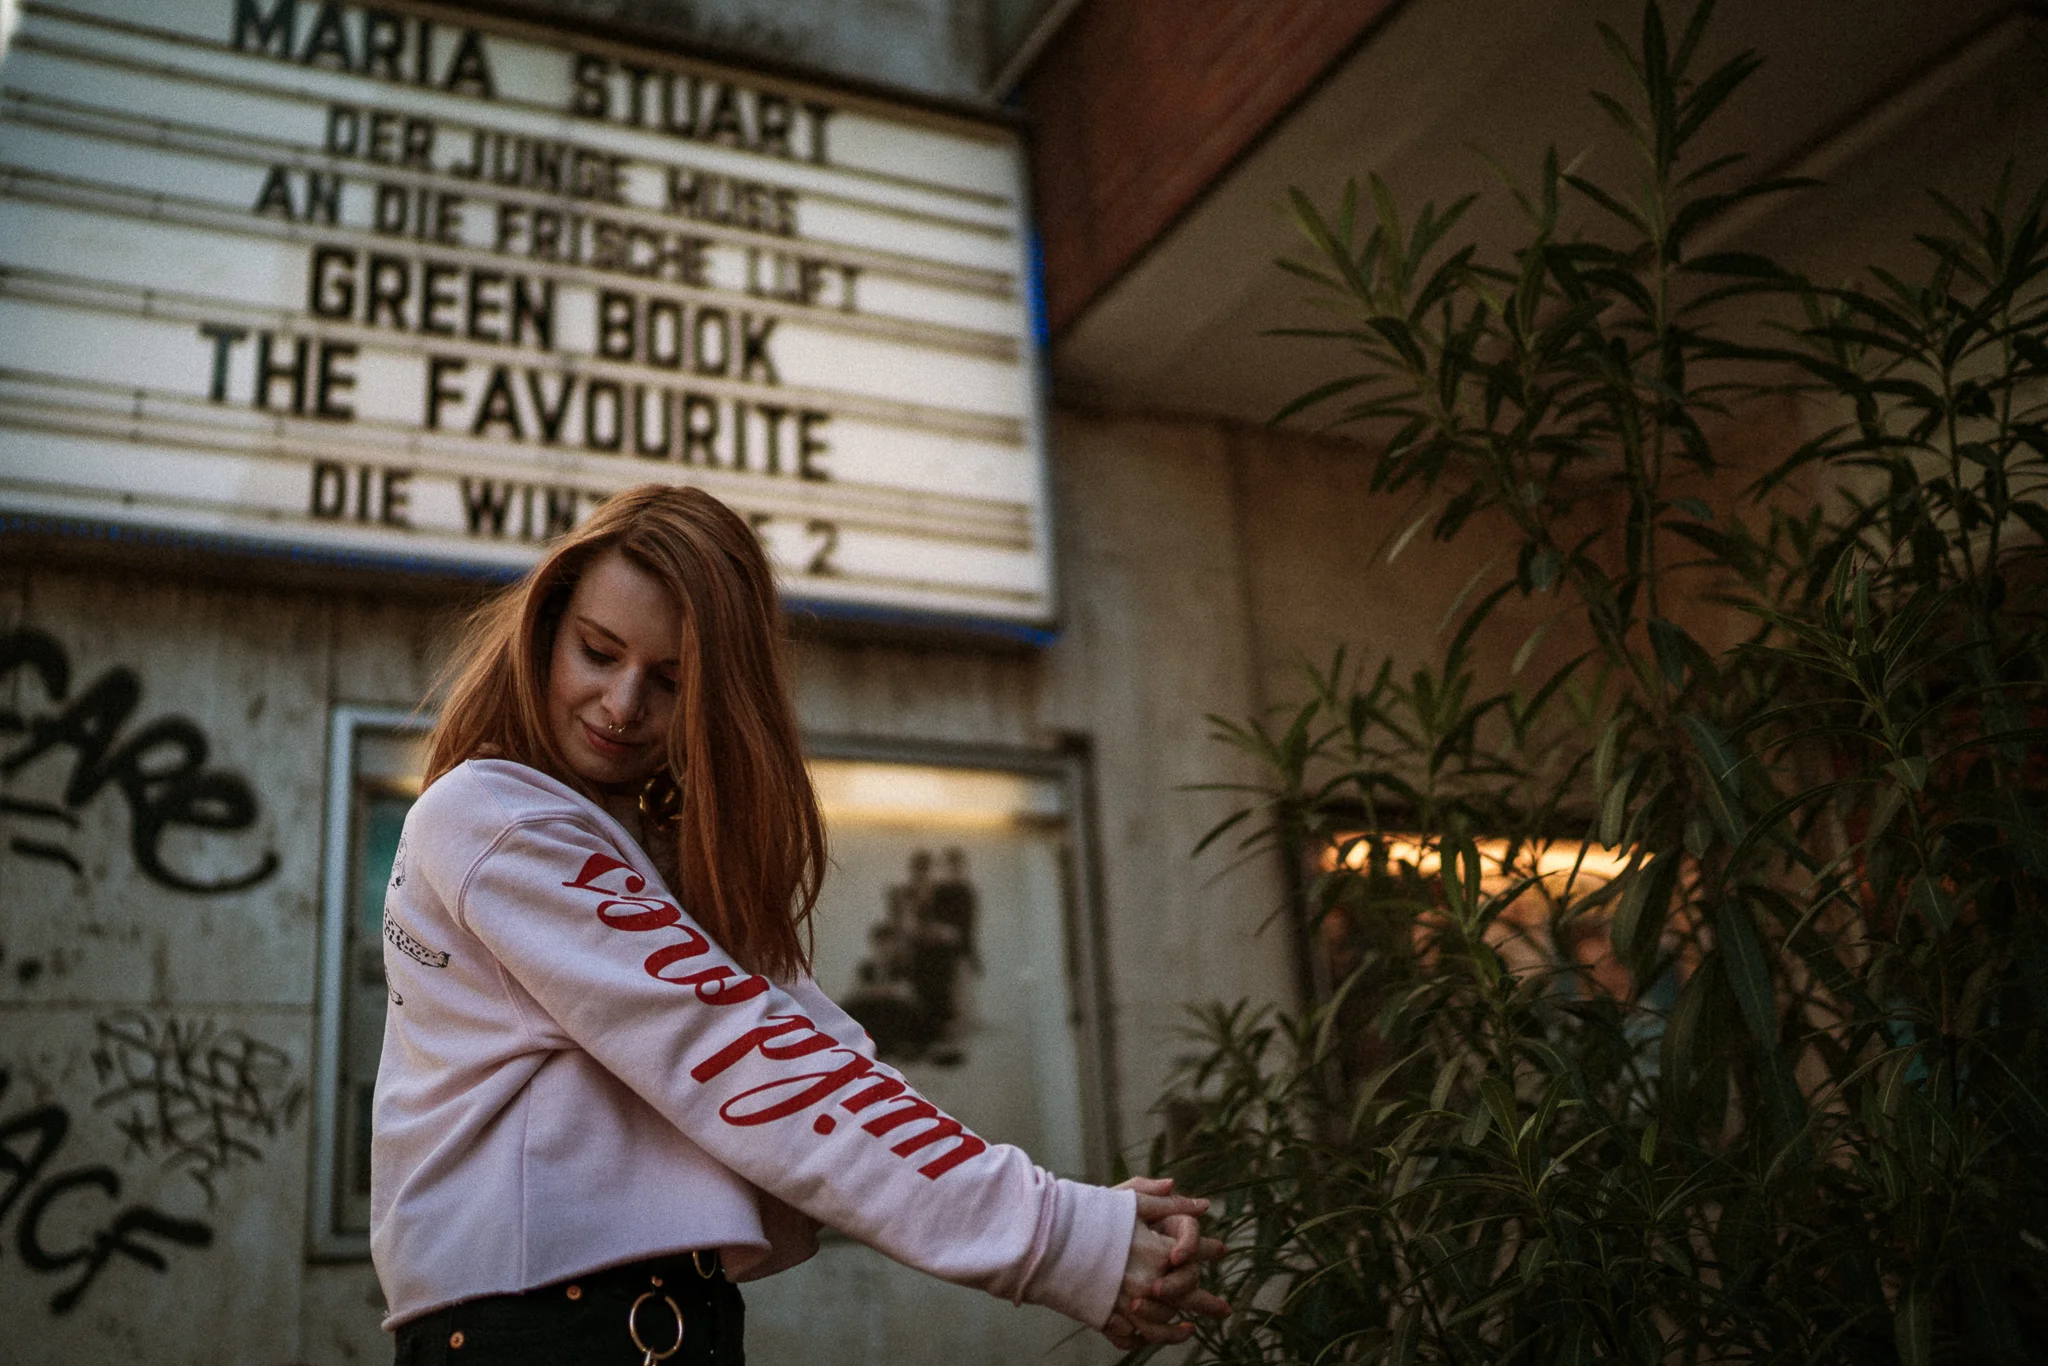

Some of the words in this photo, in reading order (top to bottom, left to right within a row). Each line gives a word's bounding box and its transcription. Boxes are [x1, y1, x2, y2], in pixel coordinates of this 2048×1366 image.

[233, 0, 496, 98] MARIA
[572, 53, 833, 164] STUART
[326, 105, 433, 167] DER
[451, 128, 630, 203] JUNGE
[254, 165, 341, 224] AN
[375, 181, 464, 247] DIE
[497, 202, 711, 290] FRISCHE
[309, 243, 557, 351] GREEN
[598, 290, 783, 387] BOOK
[199, 323, 359, 420] THE
[425, 357, 835, 482] FAVOURITE
[309, 459, 414, 528] DIE
[806, 519, 839, 576] 2
[562, 852, 770, 1006] ones
[690, 1014, 987, 1180] wild
